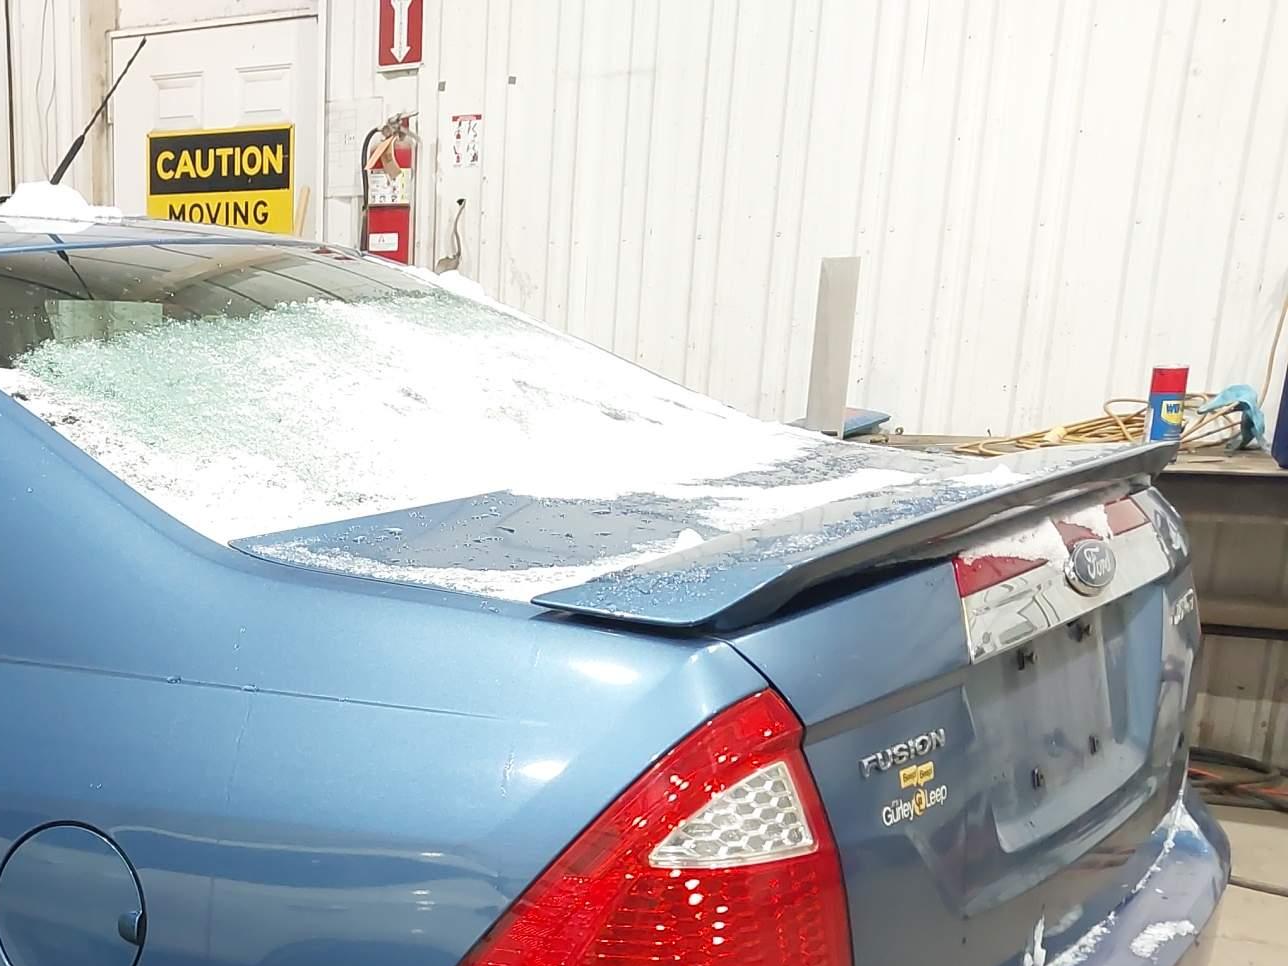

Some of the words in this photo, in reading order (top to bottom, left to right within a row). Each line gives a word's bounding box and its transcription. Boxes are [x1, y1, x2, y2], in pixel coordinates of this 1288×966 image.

[156, 143, 283, 180] CAUTION
[168, 199, 269, 226] MOVING
[1083, 546, 1113, 579] Ford
[858, 727, 946, 779] FUSION
[882, 799, 916, 827] Gurley
[924, 784, 948, 808] Leep
